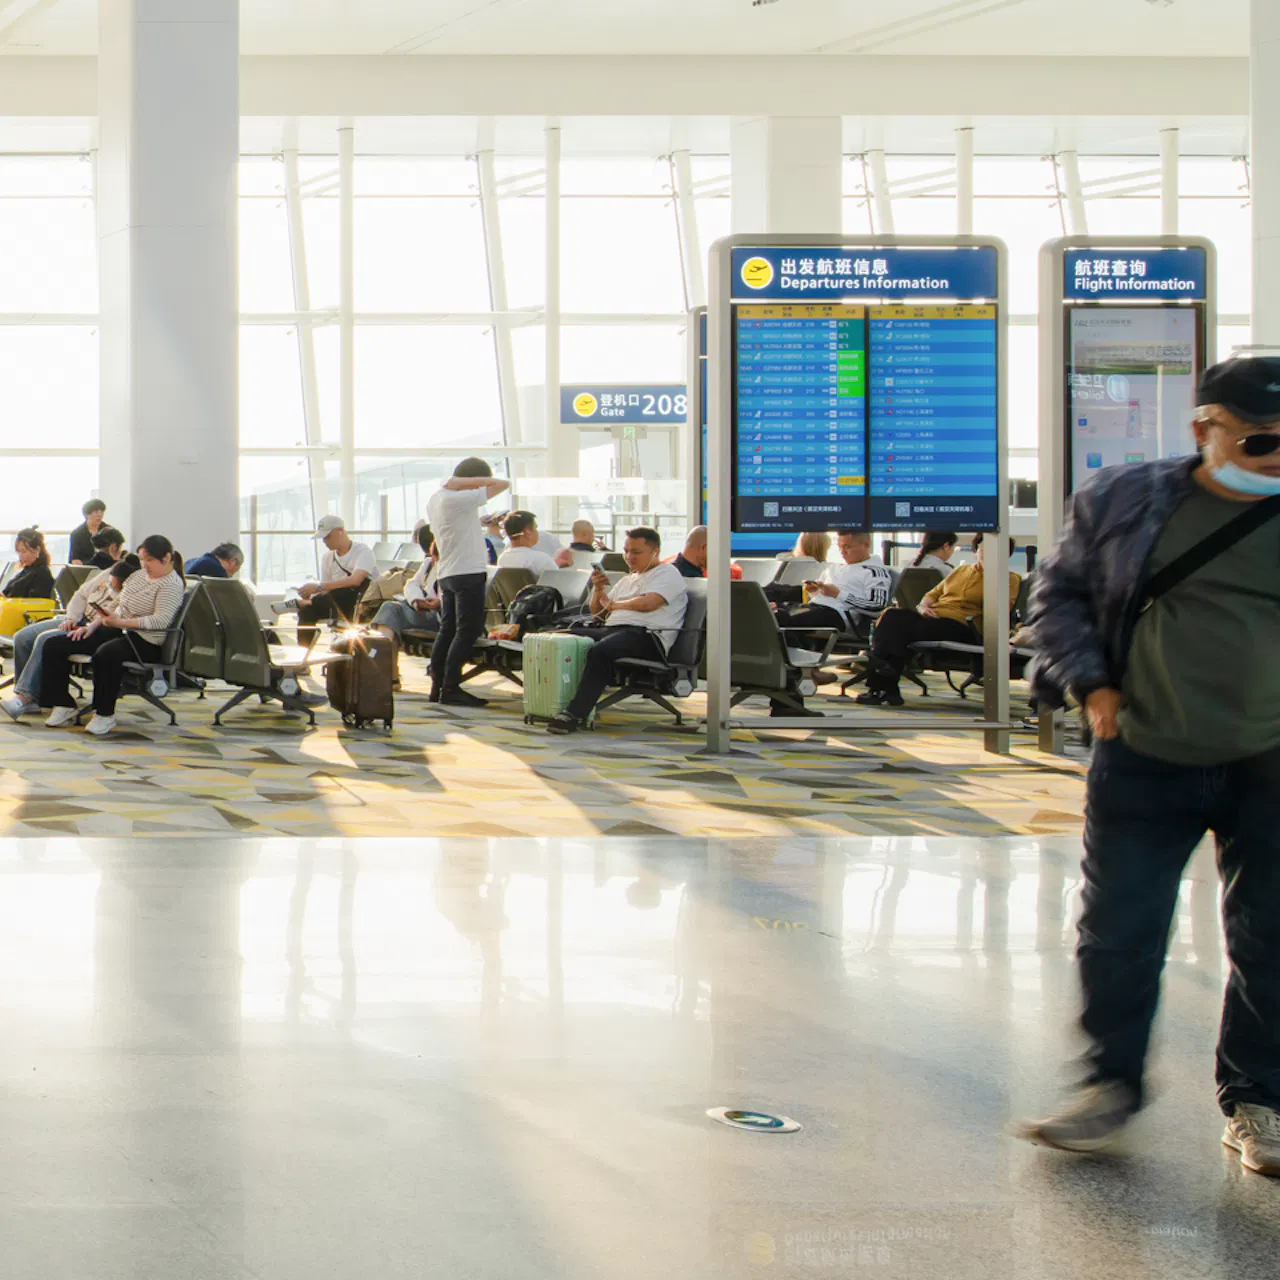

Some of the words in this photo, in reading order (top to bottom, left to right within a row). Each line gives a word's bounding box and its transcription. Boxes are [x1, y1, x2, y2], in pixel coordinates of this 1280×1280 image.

[781, 258, 888, 275] 出发航班信息
[1074, 259, 1146, 276] 航班查询
[781, 277, 860, 290] Departures
[863, 276, 949, 289] Information
[1074, 277, 1113, 292] Flight
[1115, 277, 1195, 290] Information
[600, 394, 640, 407] 登机口
[641, 394, 687, 416] 208
[600, 407, 625, 417] Gate
